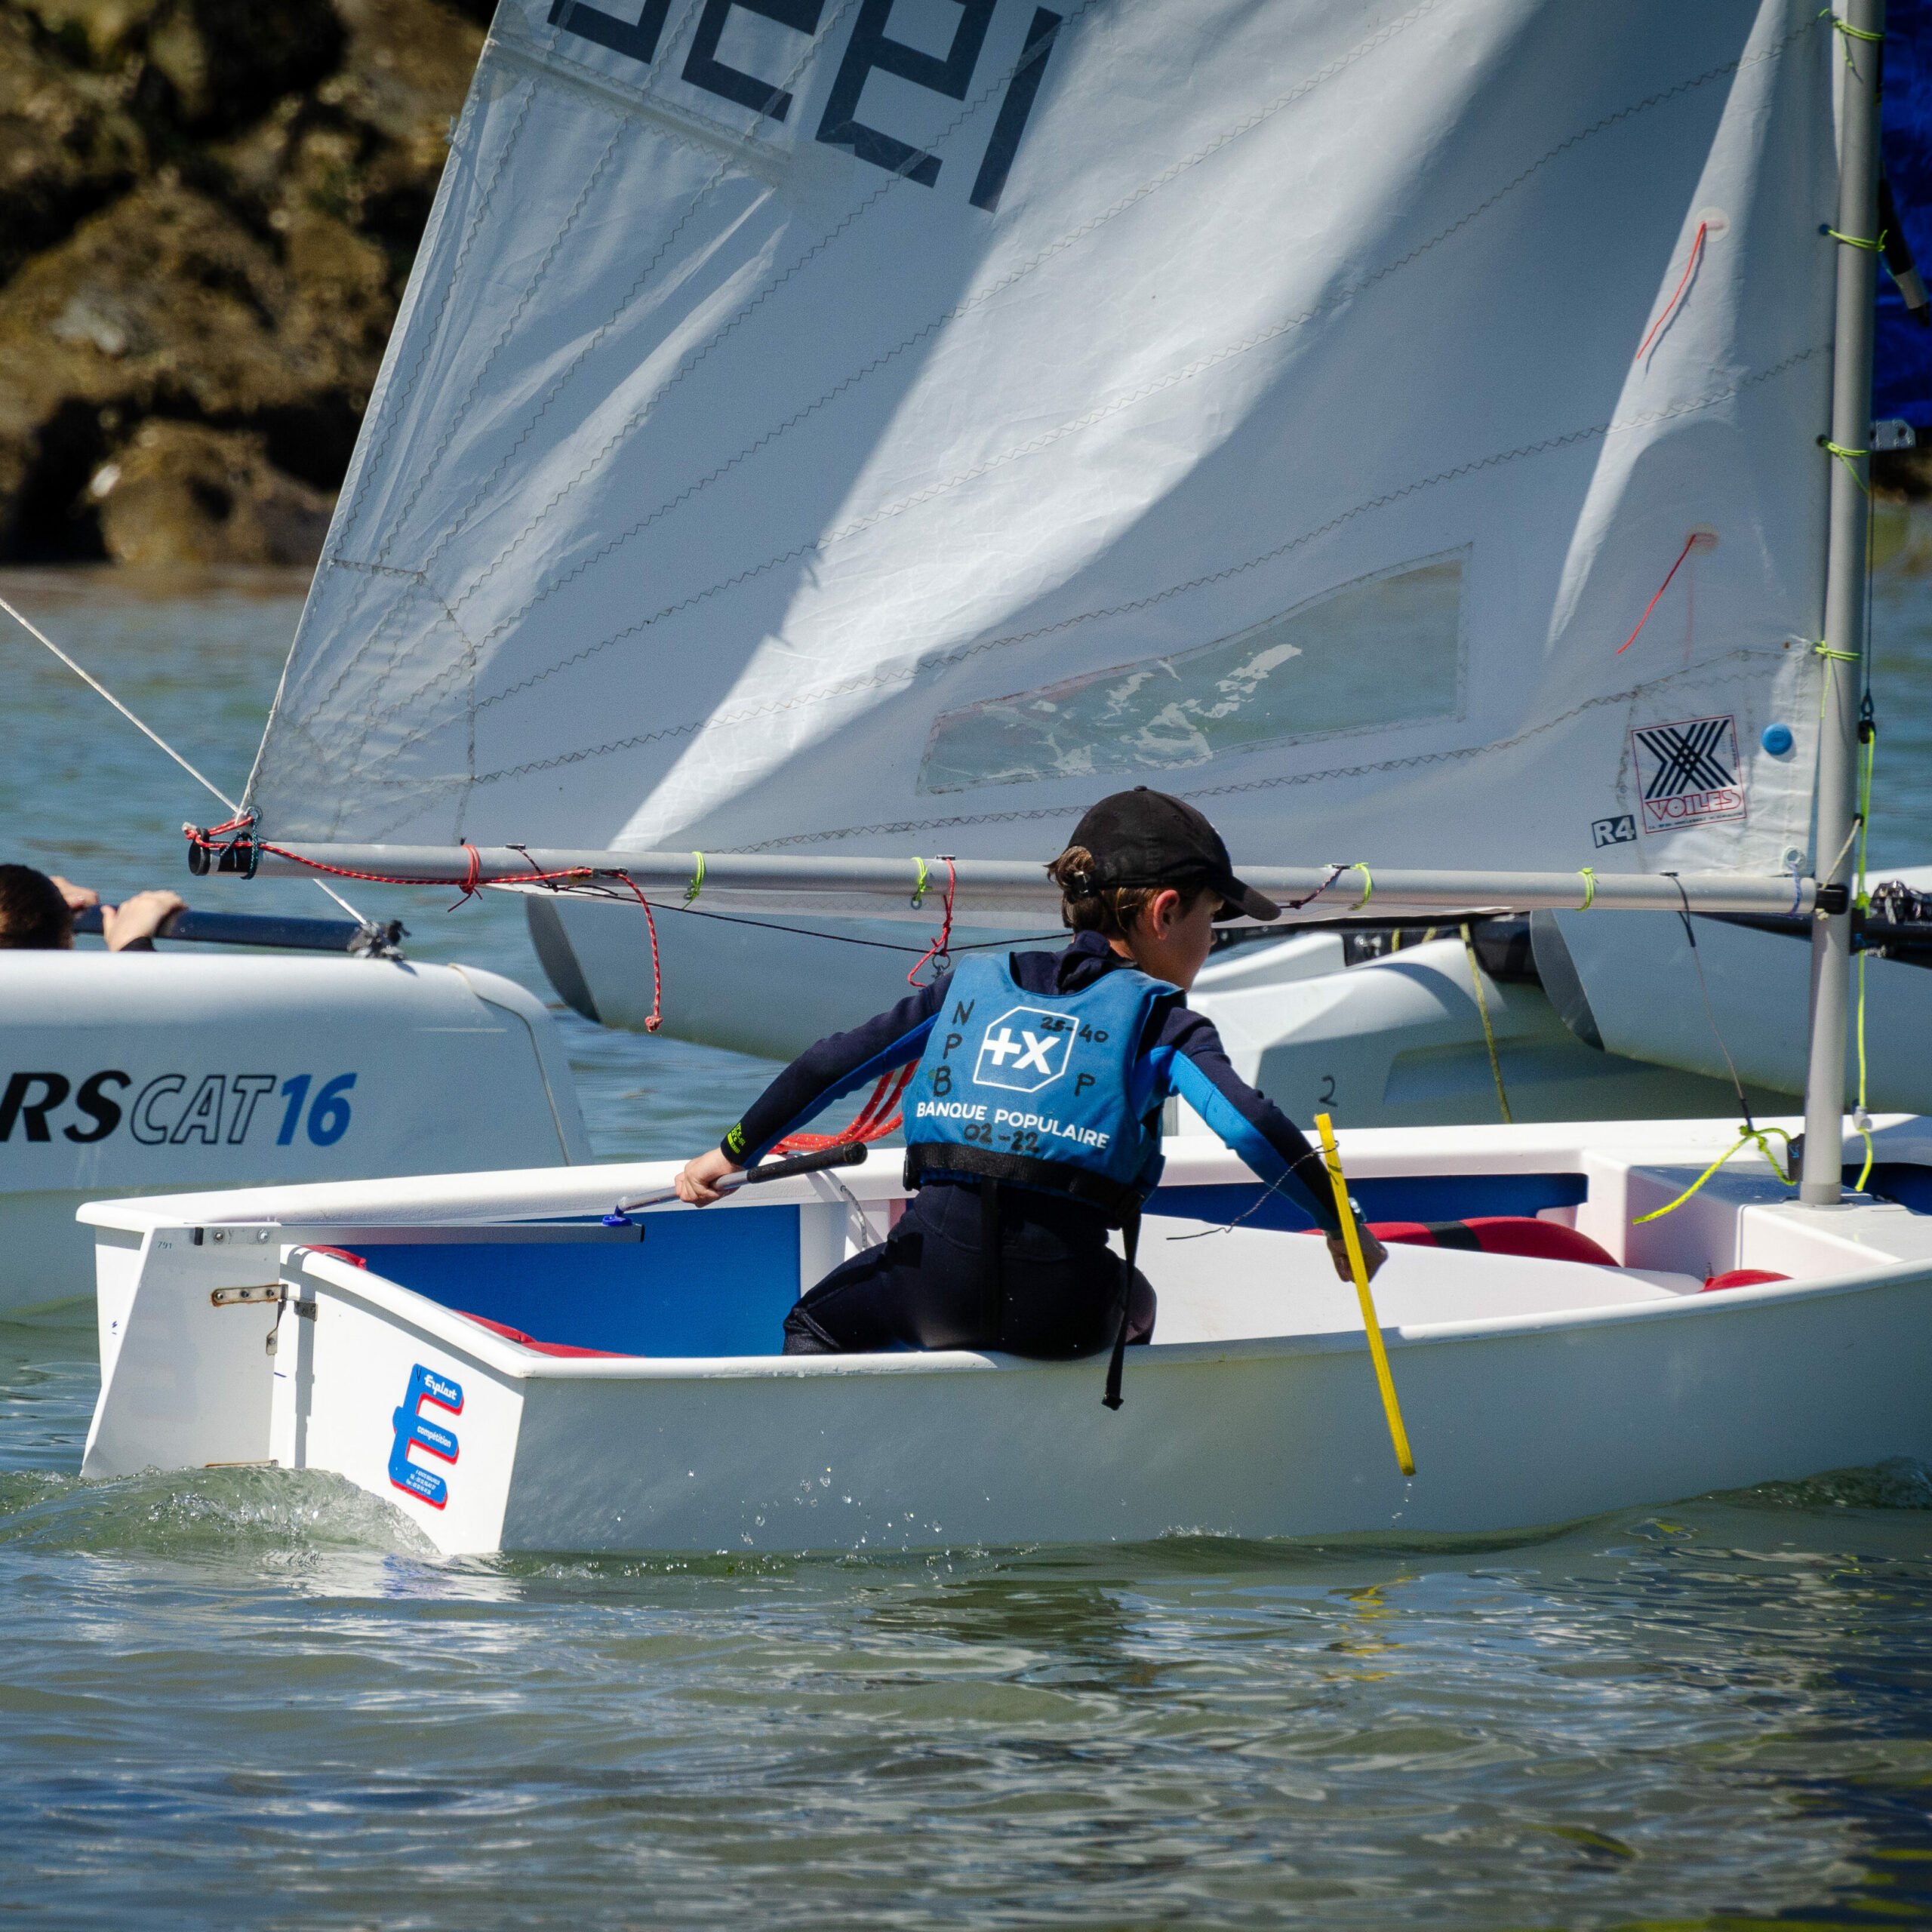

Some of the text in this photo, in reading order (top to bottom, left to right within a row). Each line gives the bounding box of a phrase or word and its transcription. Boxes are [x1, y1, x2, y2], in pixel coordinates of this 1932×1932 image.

[1644, 789, 1742, 821] VOILES
[1594, 816, 1636, 847] R4
[1075, 1073, 1096, 1097] P
[1318, 1075, 1338, 1107] 2
[916, 1101, 1110, 1149] BANQUE POPULAIRE
